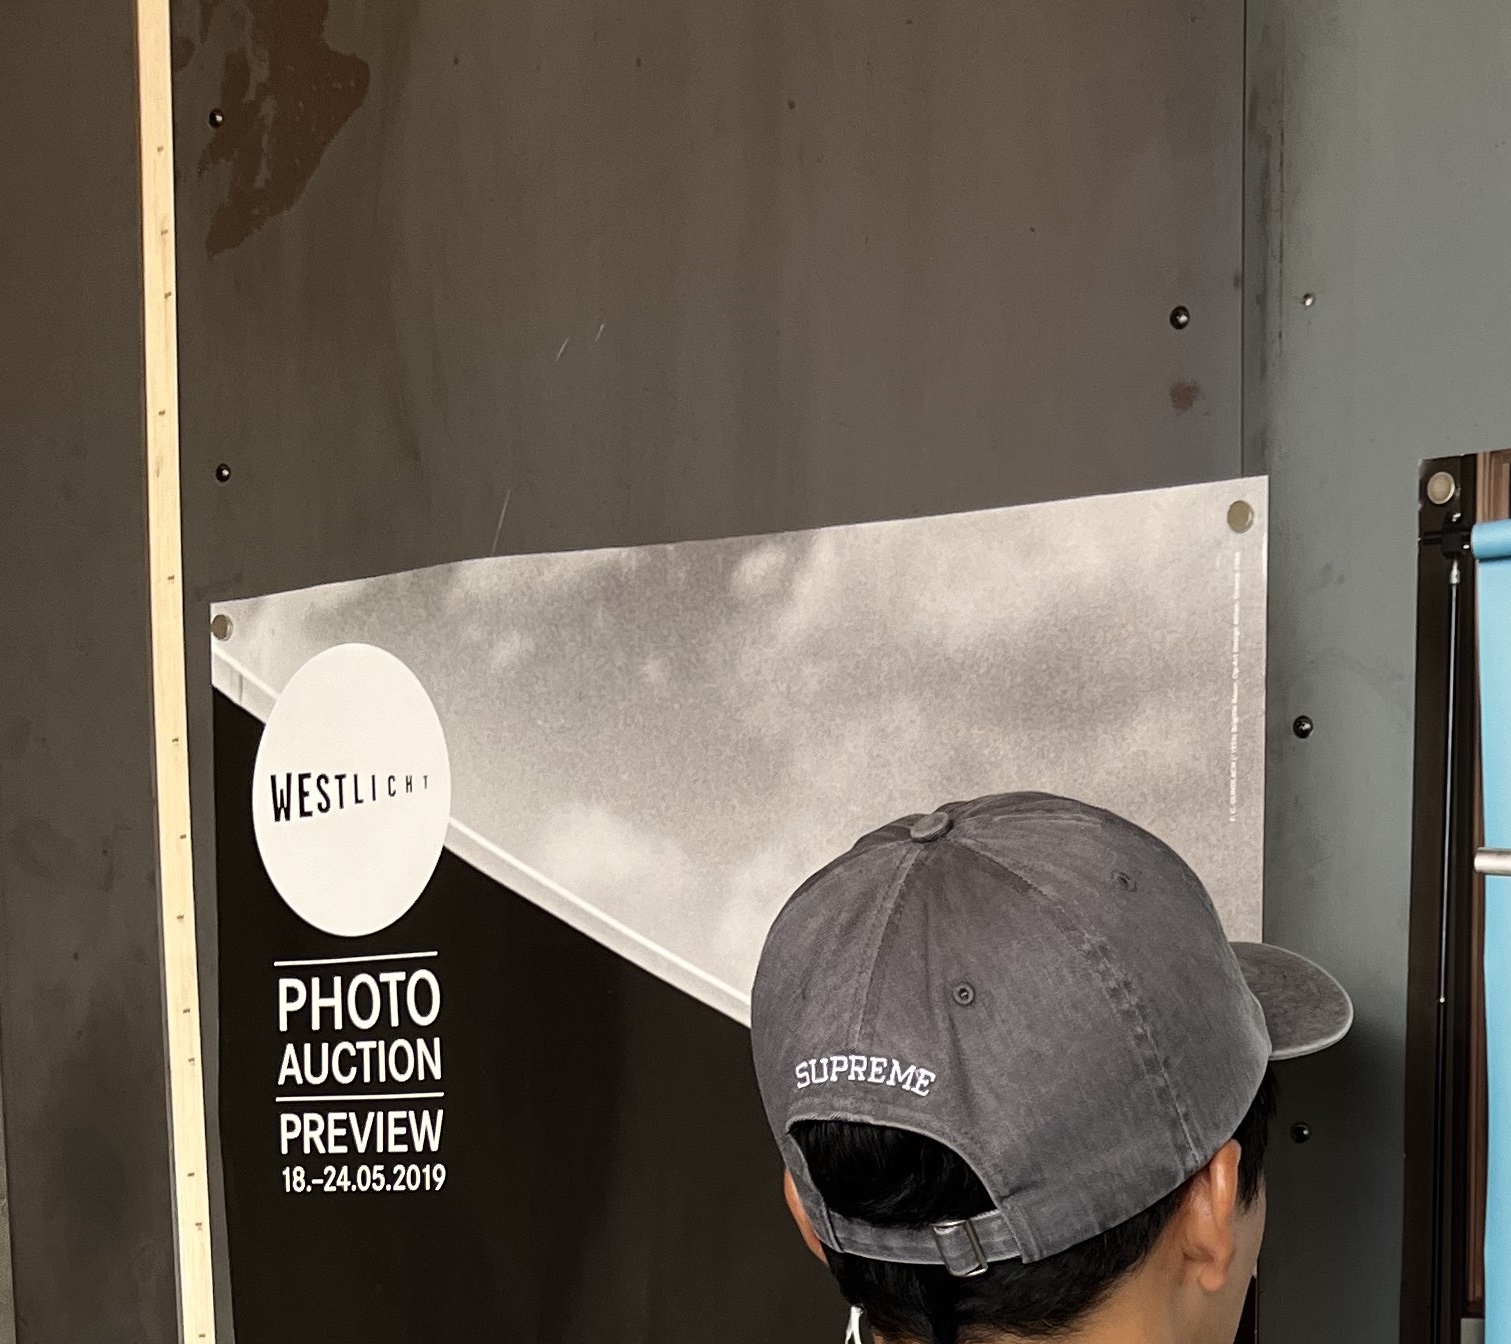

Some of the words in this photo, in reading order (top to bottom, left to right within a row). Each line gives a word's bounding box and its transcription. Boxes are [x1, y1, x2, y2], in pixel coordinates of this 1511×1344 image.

[270, 772, 429, 823] WESTLICHT
[277, 969, 441, 1032] PHOTO
[278, 1038, 442, 1086] AUCTION
[796, 1055, 935, 1097] SUPREME
[279, 1109, 444, 1155] PREVIEW
